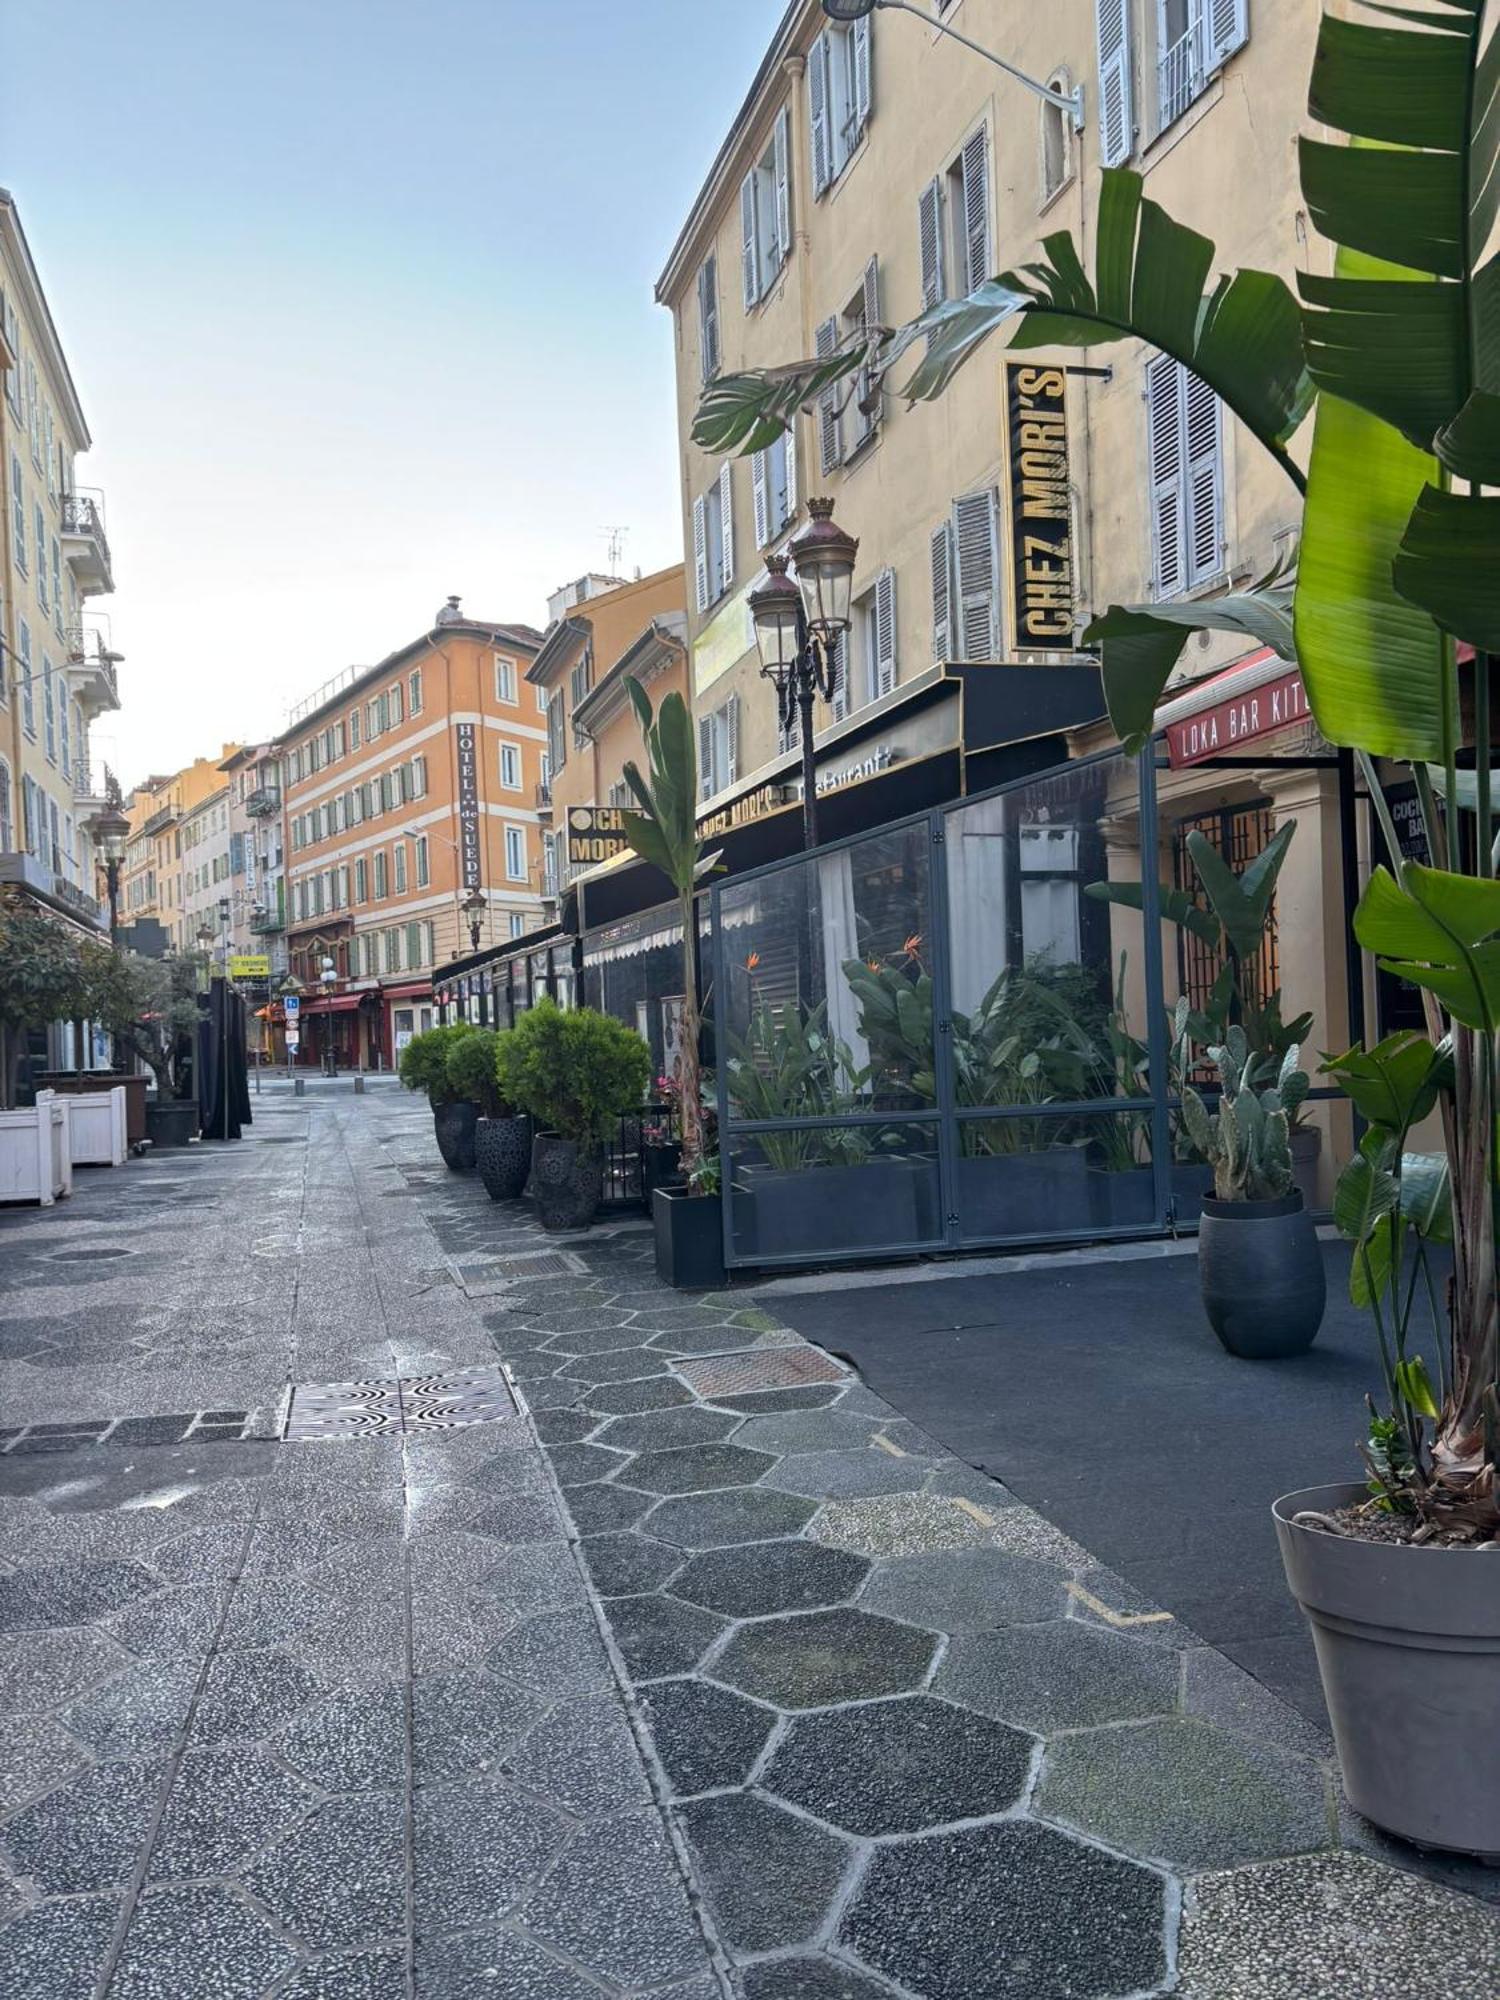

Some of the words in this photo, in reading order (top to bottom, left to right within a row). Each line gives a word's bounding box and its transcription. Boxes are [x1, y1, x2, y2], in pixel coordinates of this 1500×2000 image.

[1018, 368, 1067, 519] MORI'S
[1024, 535, 1072, 636] CHEZ
[459, 725, 473, 790] HOTEL
[1181, 717, 1219, 757] LOKA
[1230, 699, 1260, 738] BAR
[461, 810, 478, 818] de
